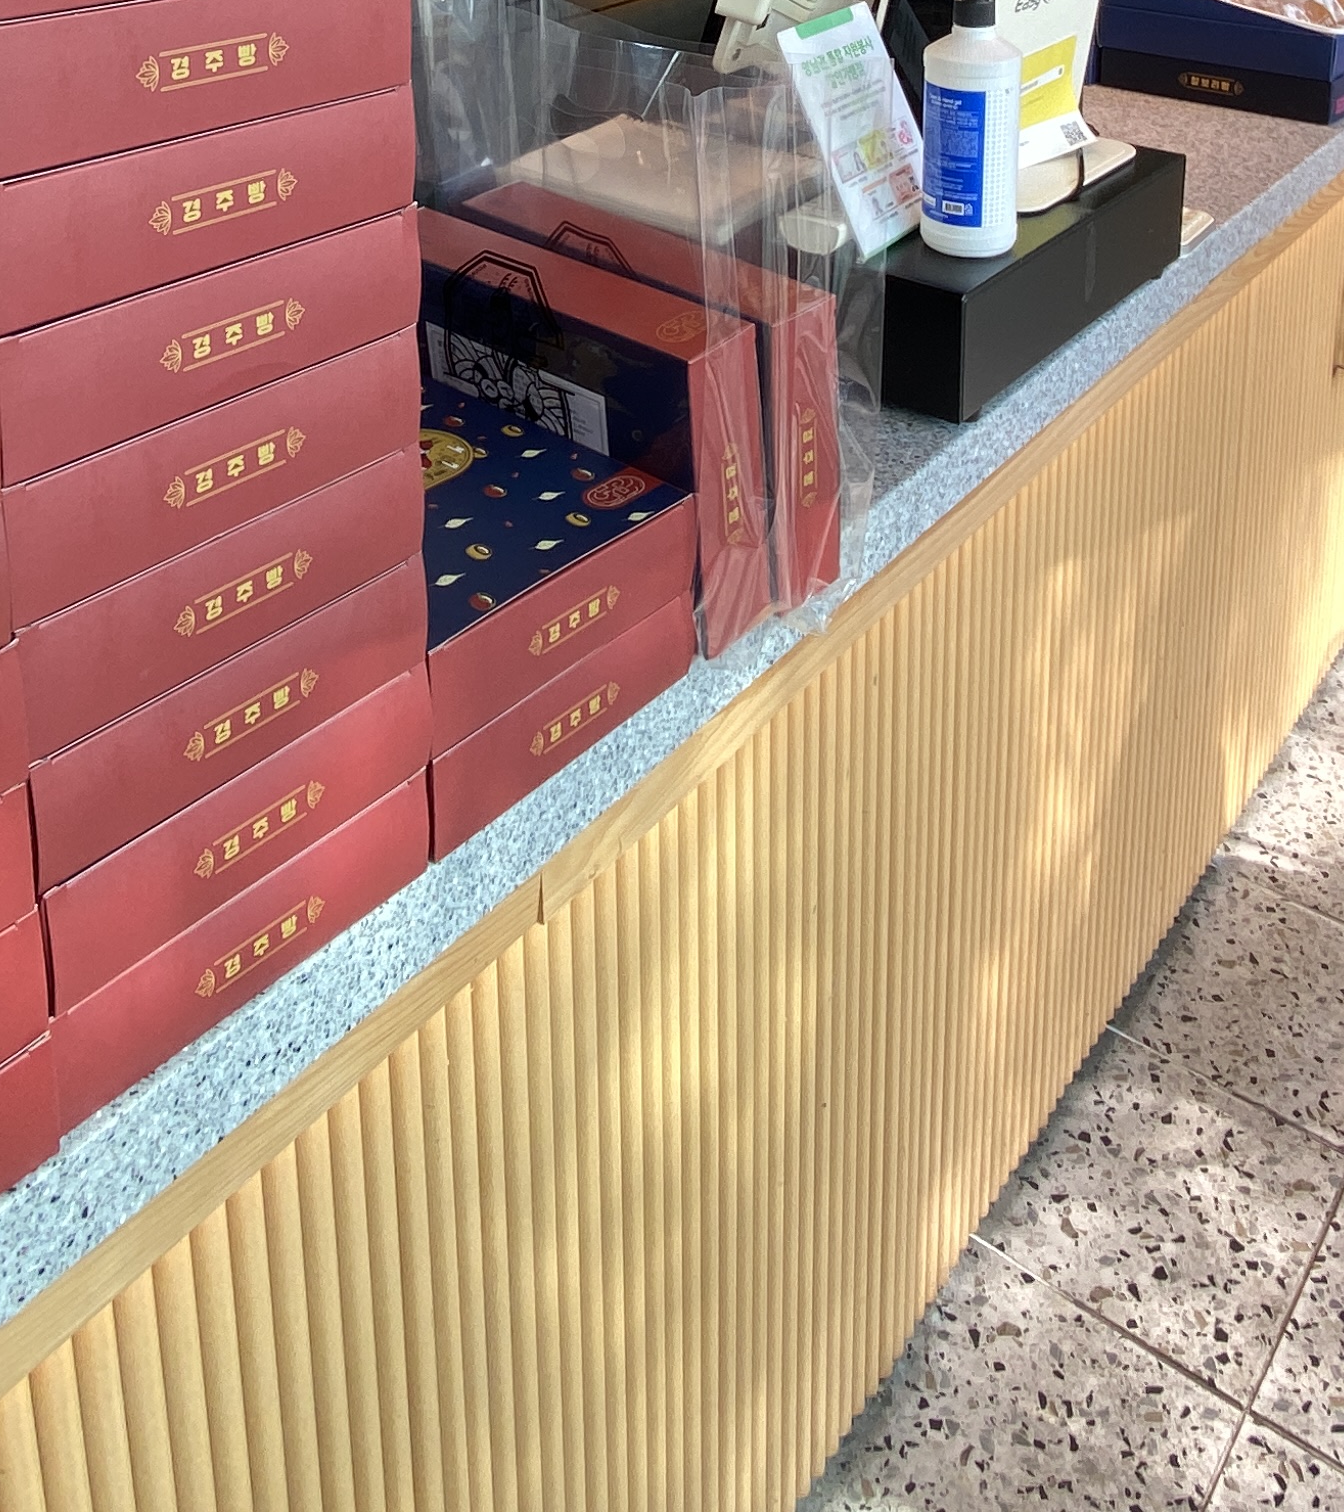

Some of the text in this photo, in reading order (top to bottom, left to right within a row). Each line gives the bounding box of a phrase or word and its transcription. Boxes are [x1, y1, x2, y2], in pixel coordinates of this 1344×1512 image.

[171, 44, 256, 79] 경주빵
[183, 181, 265, 222] 경주빵
[193, 312, 273, 358] 경주빵
[196, 443, 275, 492] 경주빵
[206, 566, 282, 620] 경주빵
[215, 686, 289, 743] 경주빵
[224, 799, 296, 859] 경주빵
[225, 915, 301, 983] 경주빵
